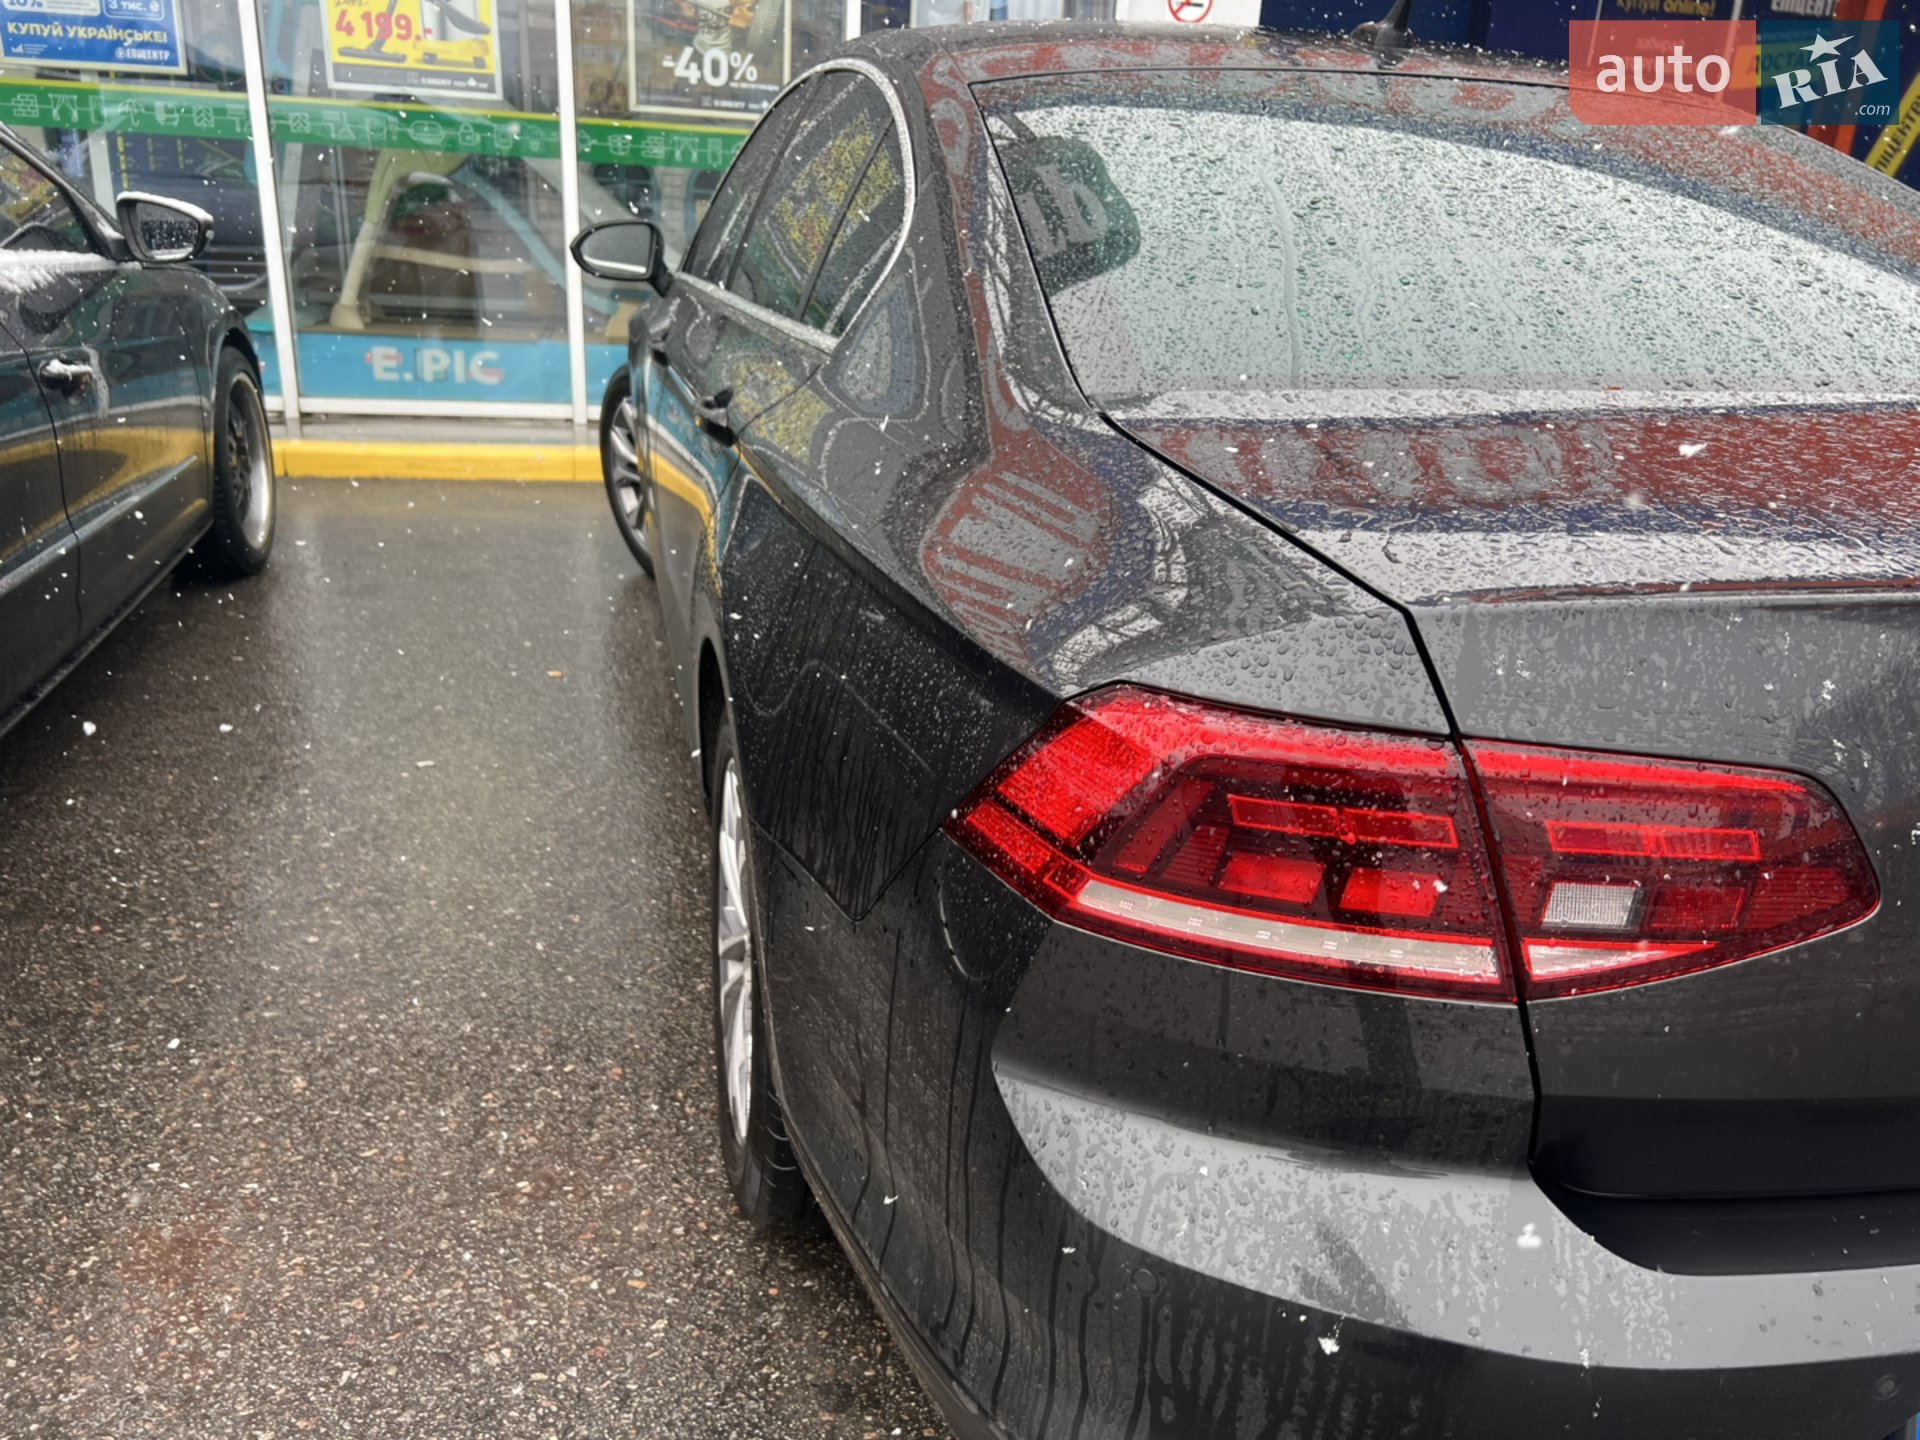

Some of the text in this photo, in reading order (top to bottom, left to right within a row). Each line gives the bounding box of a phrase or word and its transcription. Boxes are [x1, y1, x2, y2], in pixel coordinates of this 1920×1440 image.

[7, 21, 168, 43] КУПУЙ УКРАЇНСЬКЕ!
[371, 345, 501, 386] E.PIC
